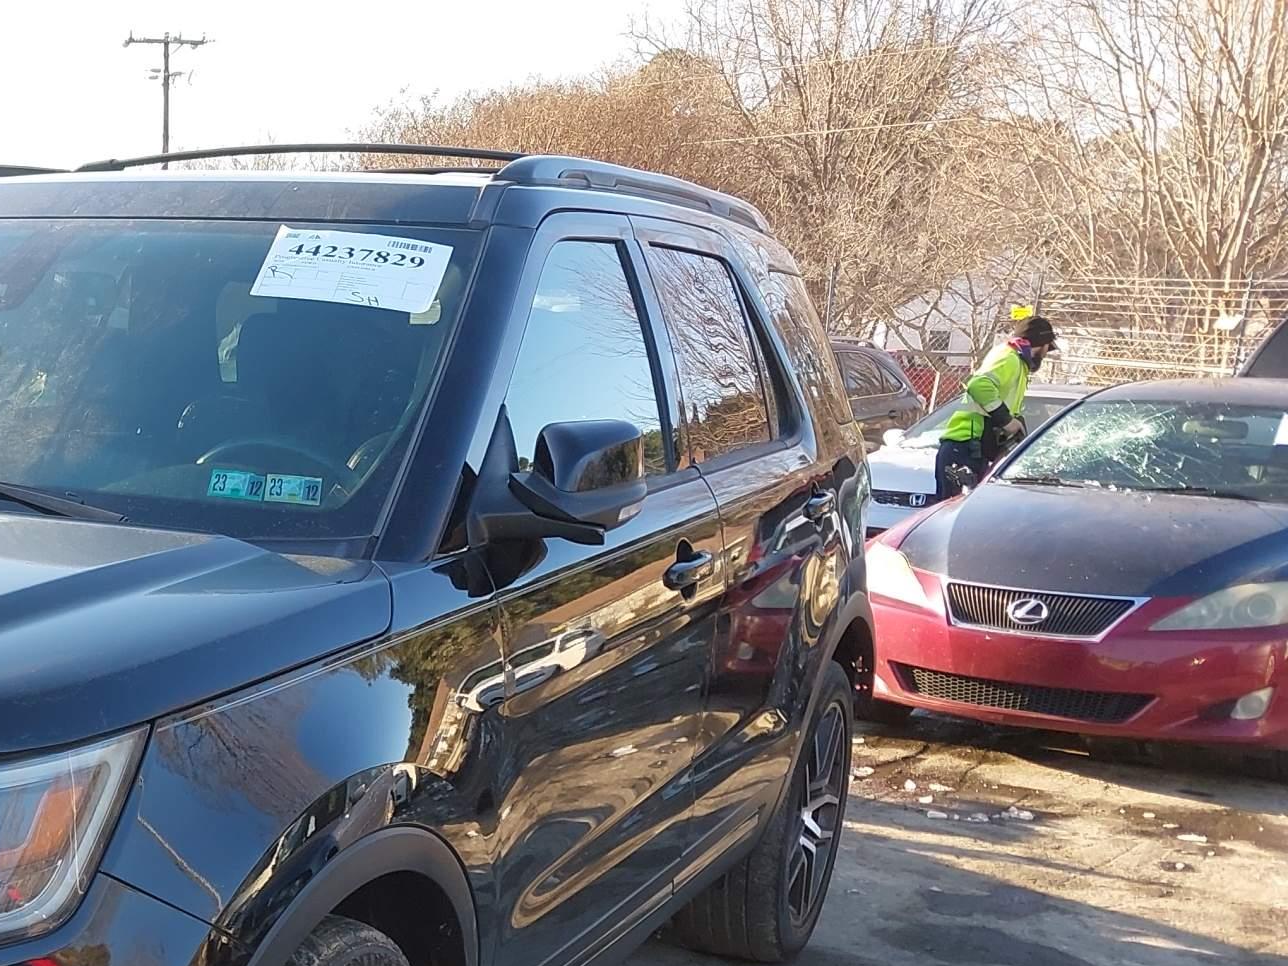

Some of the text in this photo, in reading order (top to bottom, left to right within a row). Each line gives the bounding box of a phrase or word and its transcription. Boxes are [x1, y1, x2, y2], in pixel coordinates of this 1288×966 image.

[288, 243, 425, 268] 44237829
[213, 473, 263, 497] 23 12
[269, 478, 319, 501] 23 12
